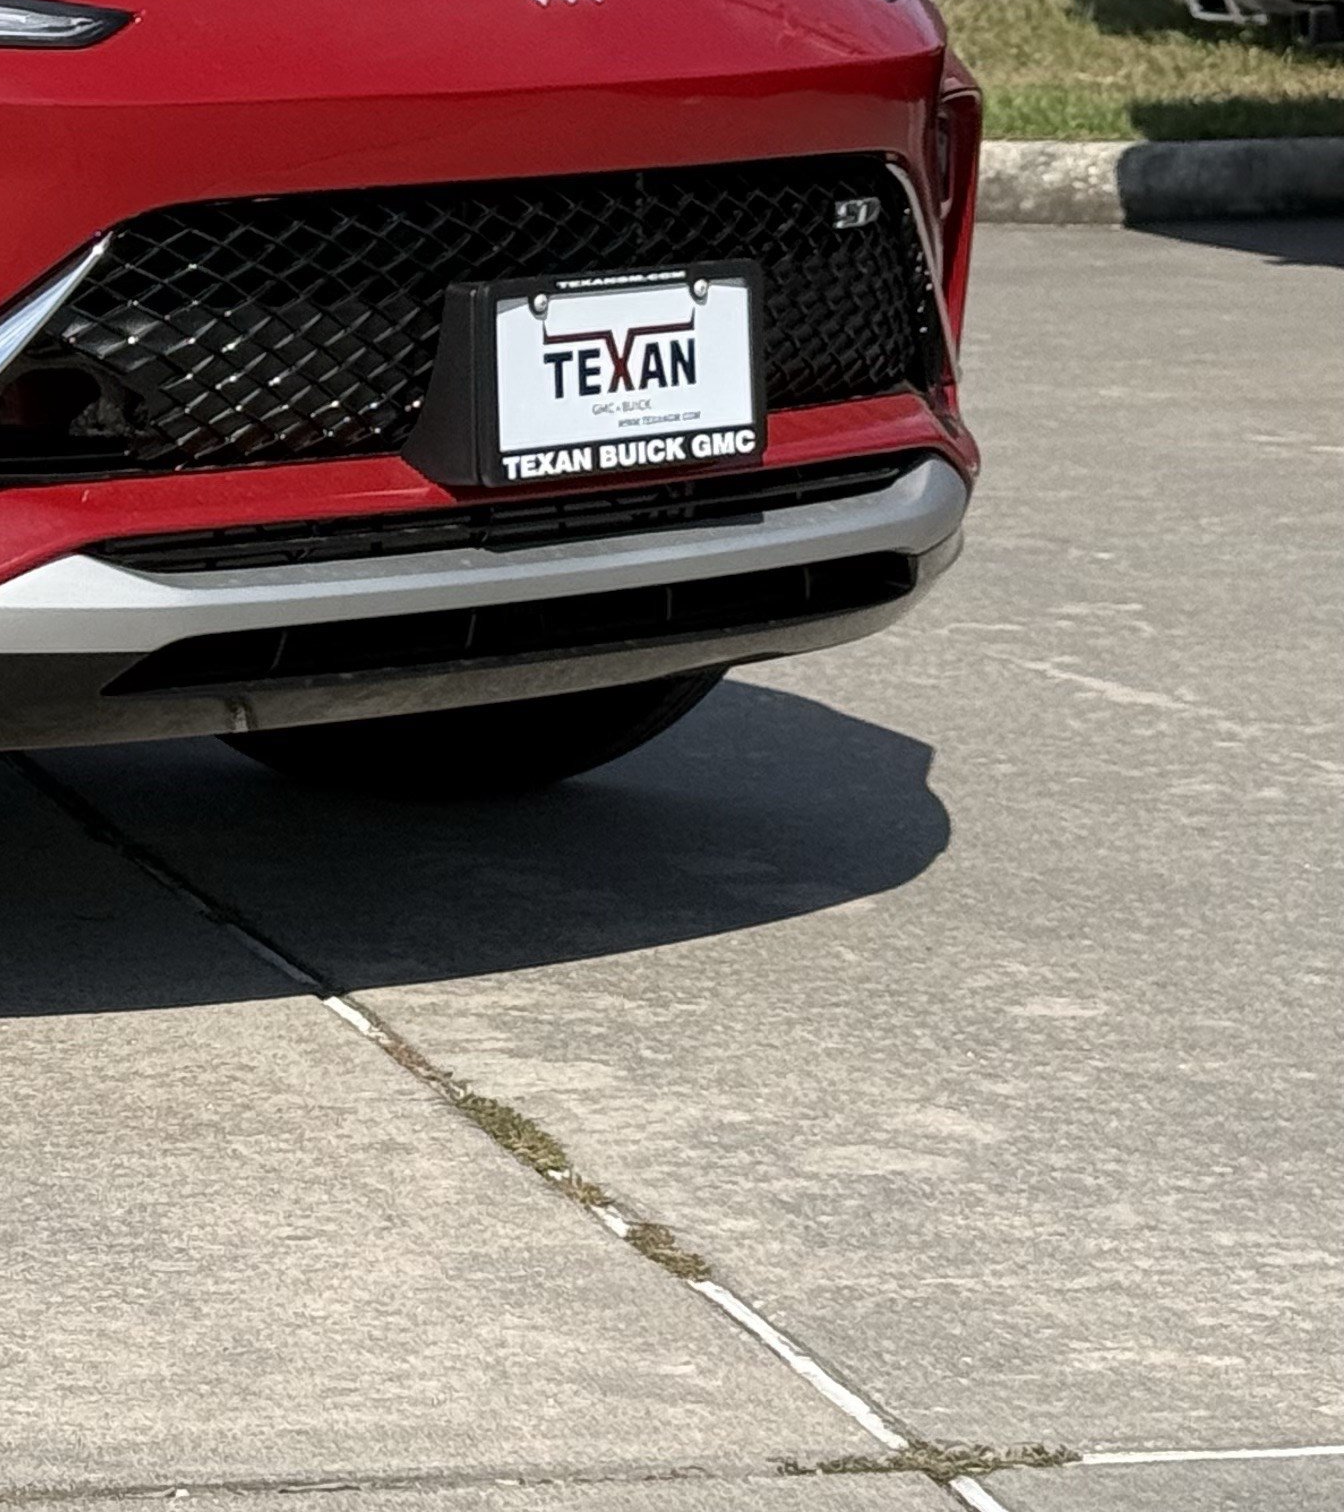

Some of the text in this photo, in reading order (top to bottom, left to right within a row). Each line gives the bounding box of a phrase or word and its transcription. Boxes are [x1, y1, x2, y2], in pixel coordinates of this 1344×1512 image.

[543, 326, 697, 399] TEXAN
[502, 429, 757, 481] TEXAN BUICK GMC
